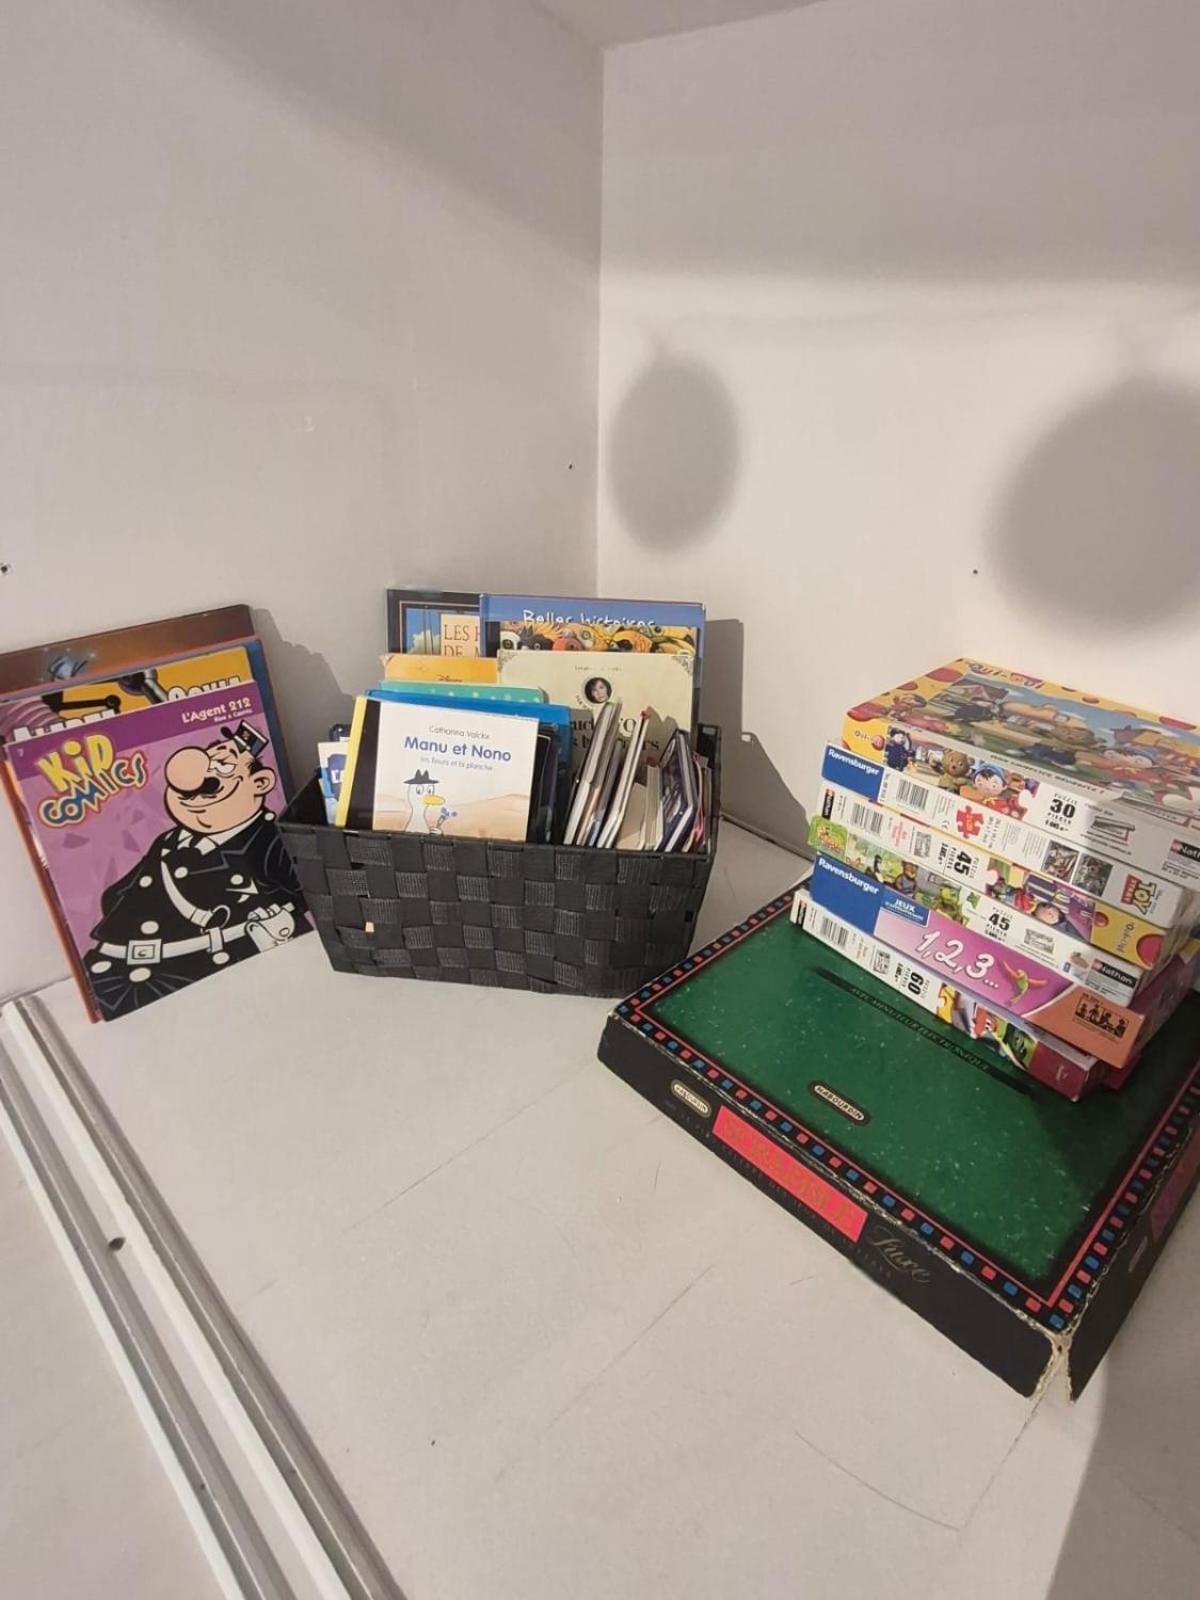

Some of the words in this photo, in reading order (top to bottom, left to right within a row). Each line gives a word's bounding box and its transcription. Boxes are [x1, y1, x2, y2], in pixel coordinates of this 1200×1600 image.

[444, 624, 470, 641] LES
[181, 703, 226, 724] L'Agent
[229, 698, 252, 713] 212
[404, 735, 448, 754] Manu
[452, 743, 468, 756] et
[471, 745, 512, 762] Nono
[828, 748, 880, 776] Ravensburger
[1050, 798, 1076, 818] 30
[818, 857, 879, 895] Ravensburger
[954, 850, 973, 877] 45
[1132, 878, 1158, 916] TOY
[988, 913, 1010, 931] 45
[908, 971, 925, 995] 60
[1101, 963, 1134, 985] Nathan
